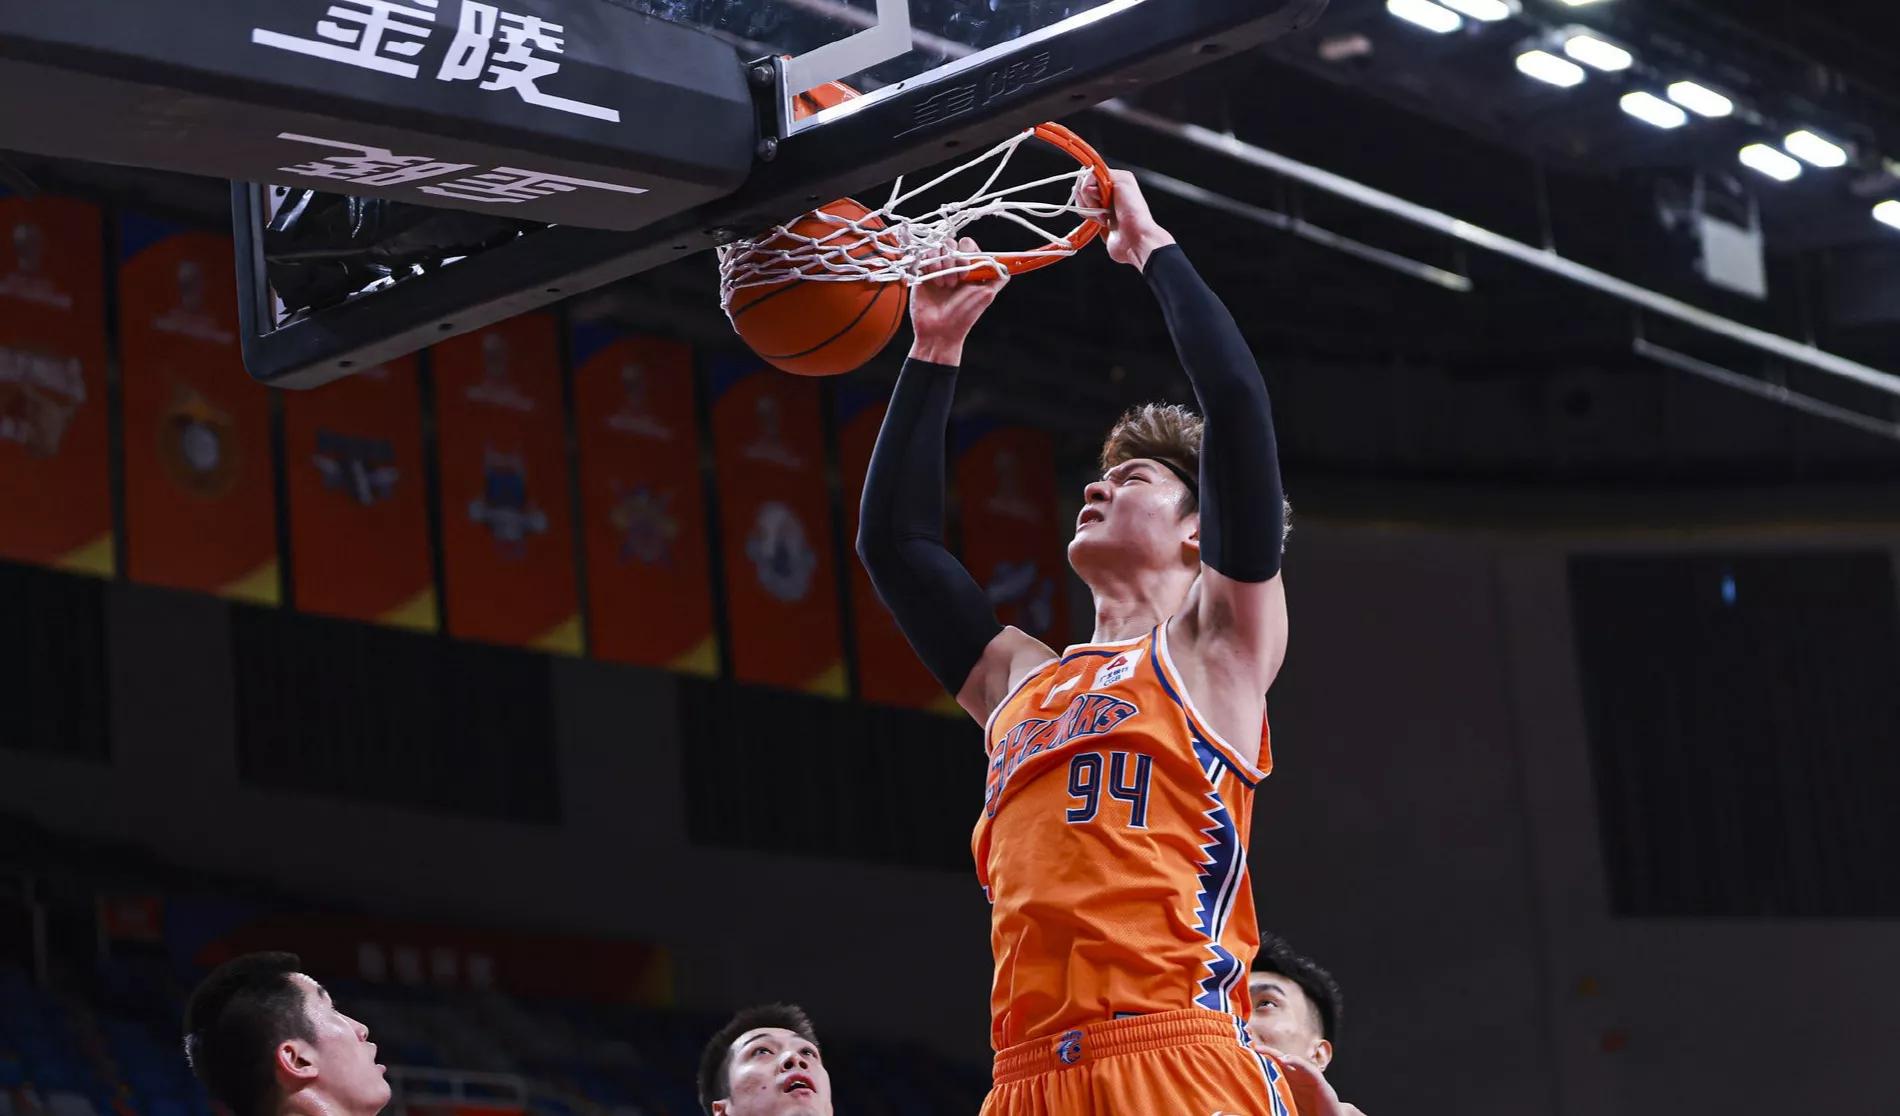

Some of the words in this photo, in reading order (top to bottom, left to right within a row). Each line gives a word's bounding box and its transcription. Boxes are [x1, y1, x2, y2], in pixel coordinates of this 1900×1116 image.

[251, 0, 621, 123] 金陵
[984, 693, 1140, 818] SHARKS
[1065, 751, 1153, 830] 94
